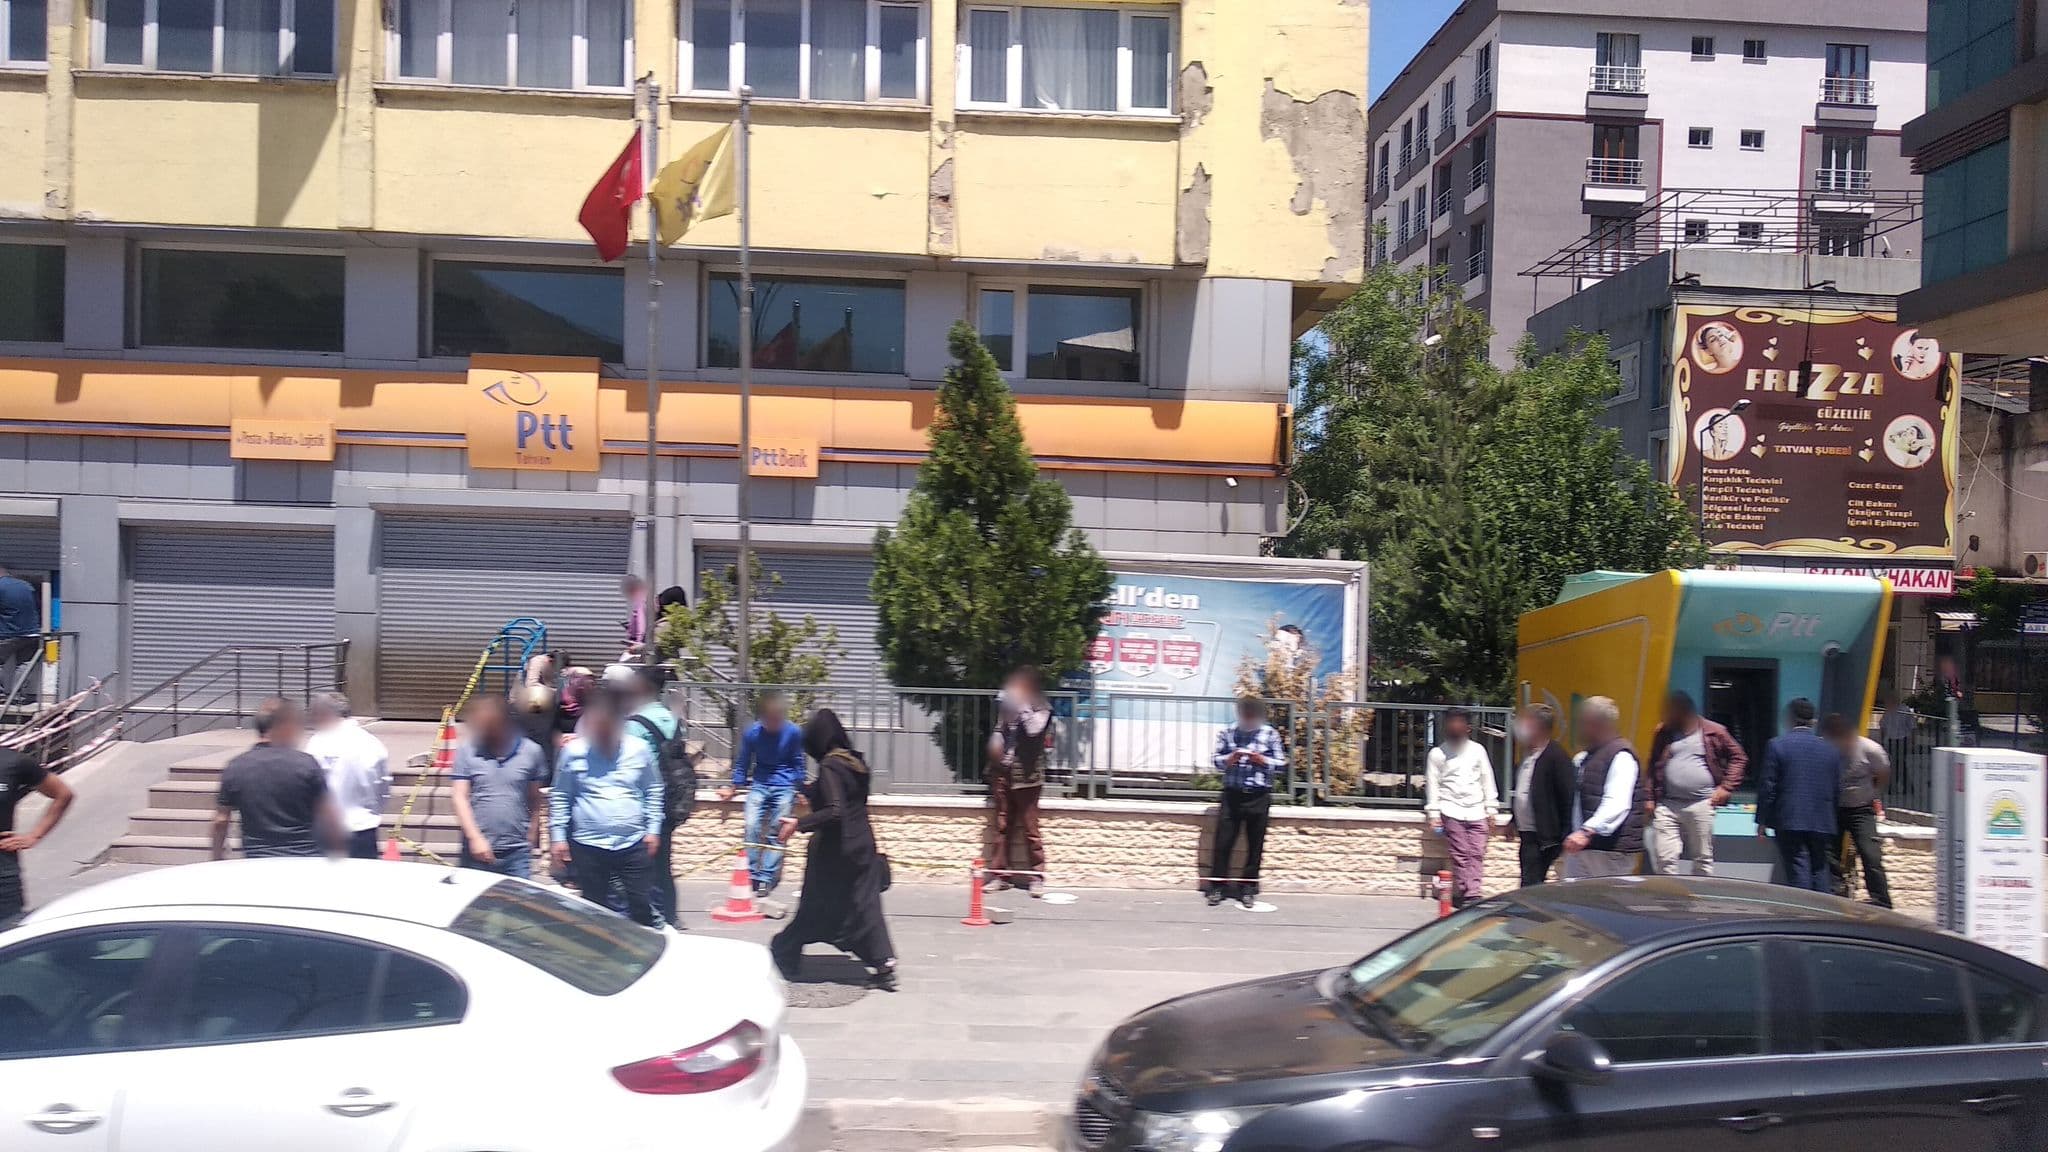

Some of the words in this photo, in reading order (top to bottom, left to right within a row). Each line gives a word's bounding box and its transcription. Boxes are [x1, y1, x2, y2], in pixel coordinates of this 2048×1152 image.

[1817, 406, 1872, 420] GÜZELLİK
[516, 410, 575, 450] Ptt
[751, 446, 808, 468] PttBank
[1774, 445, 1813, 454] TATVAN
[1815, 446, 1853, 456] ŞUBESİ
[1888, 569, 1949, 588] HAKAN
[1768, 611, 1821, 638] Ptt
